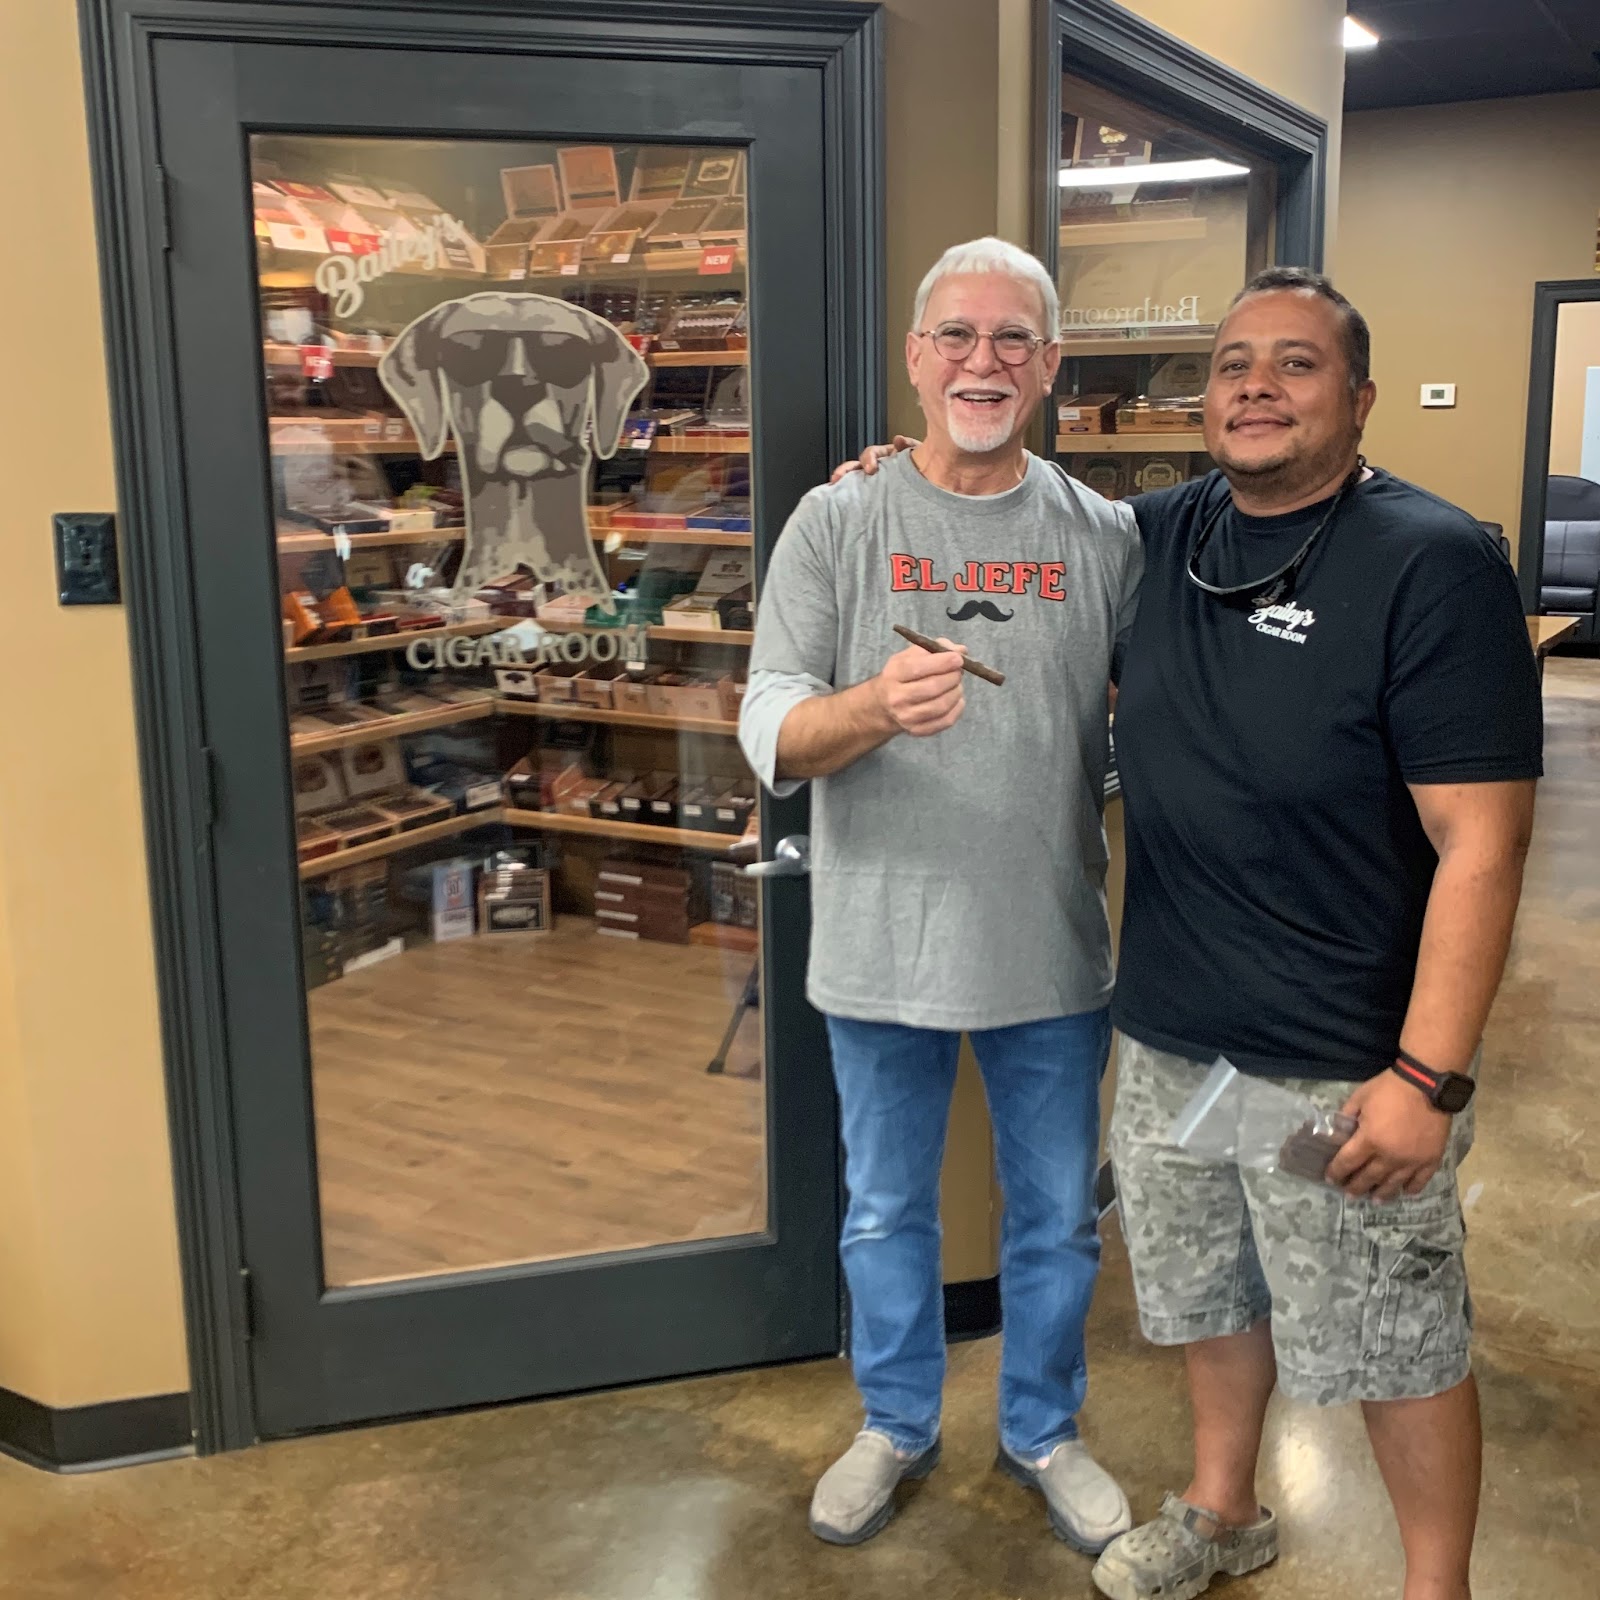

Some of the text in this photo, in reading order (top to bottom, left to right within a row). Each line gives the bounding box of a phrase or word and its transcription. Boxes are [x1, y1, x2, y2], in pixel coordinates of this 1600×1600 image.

[315, 213, 464, 319] Bailey's
[704, 254, 731, 266] NEW
[890, 553, 1067, 601] EL JEFE
[405, 631, 648, 671] CIGAR ROOM
[1255, 622, 1307, 645] CIGAR ROOM
